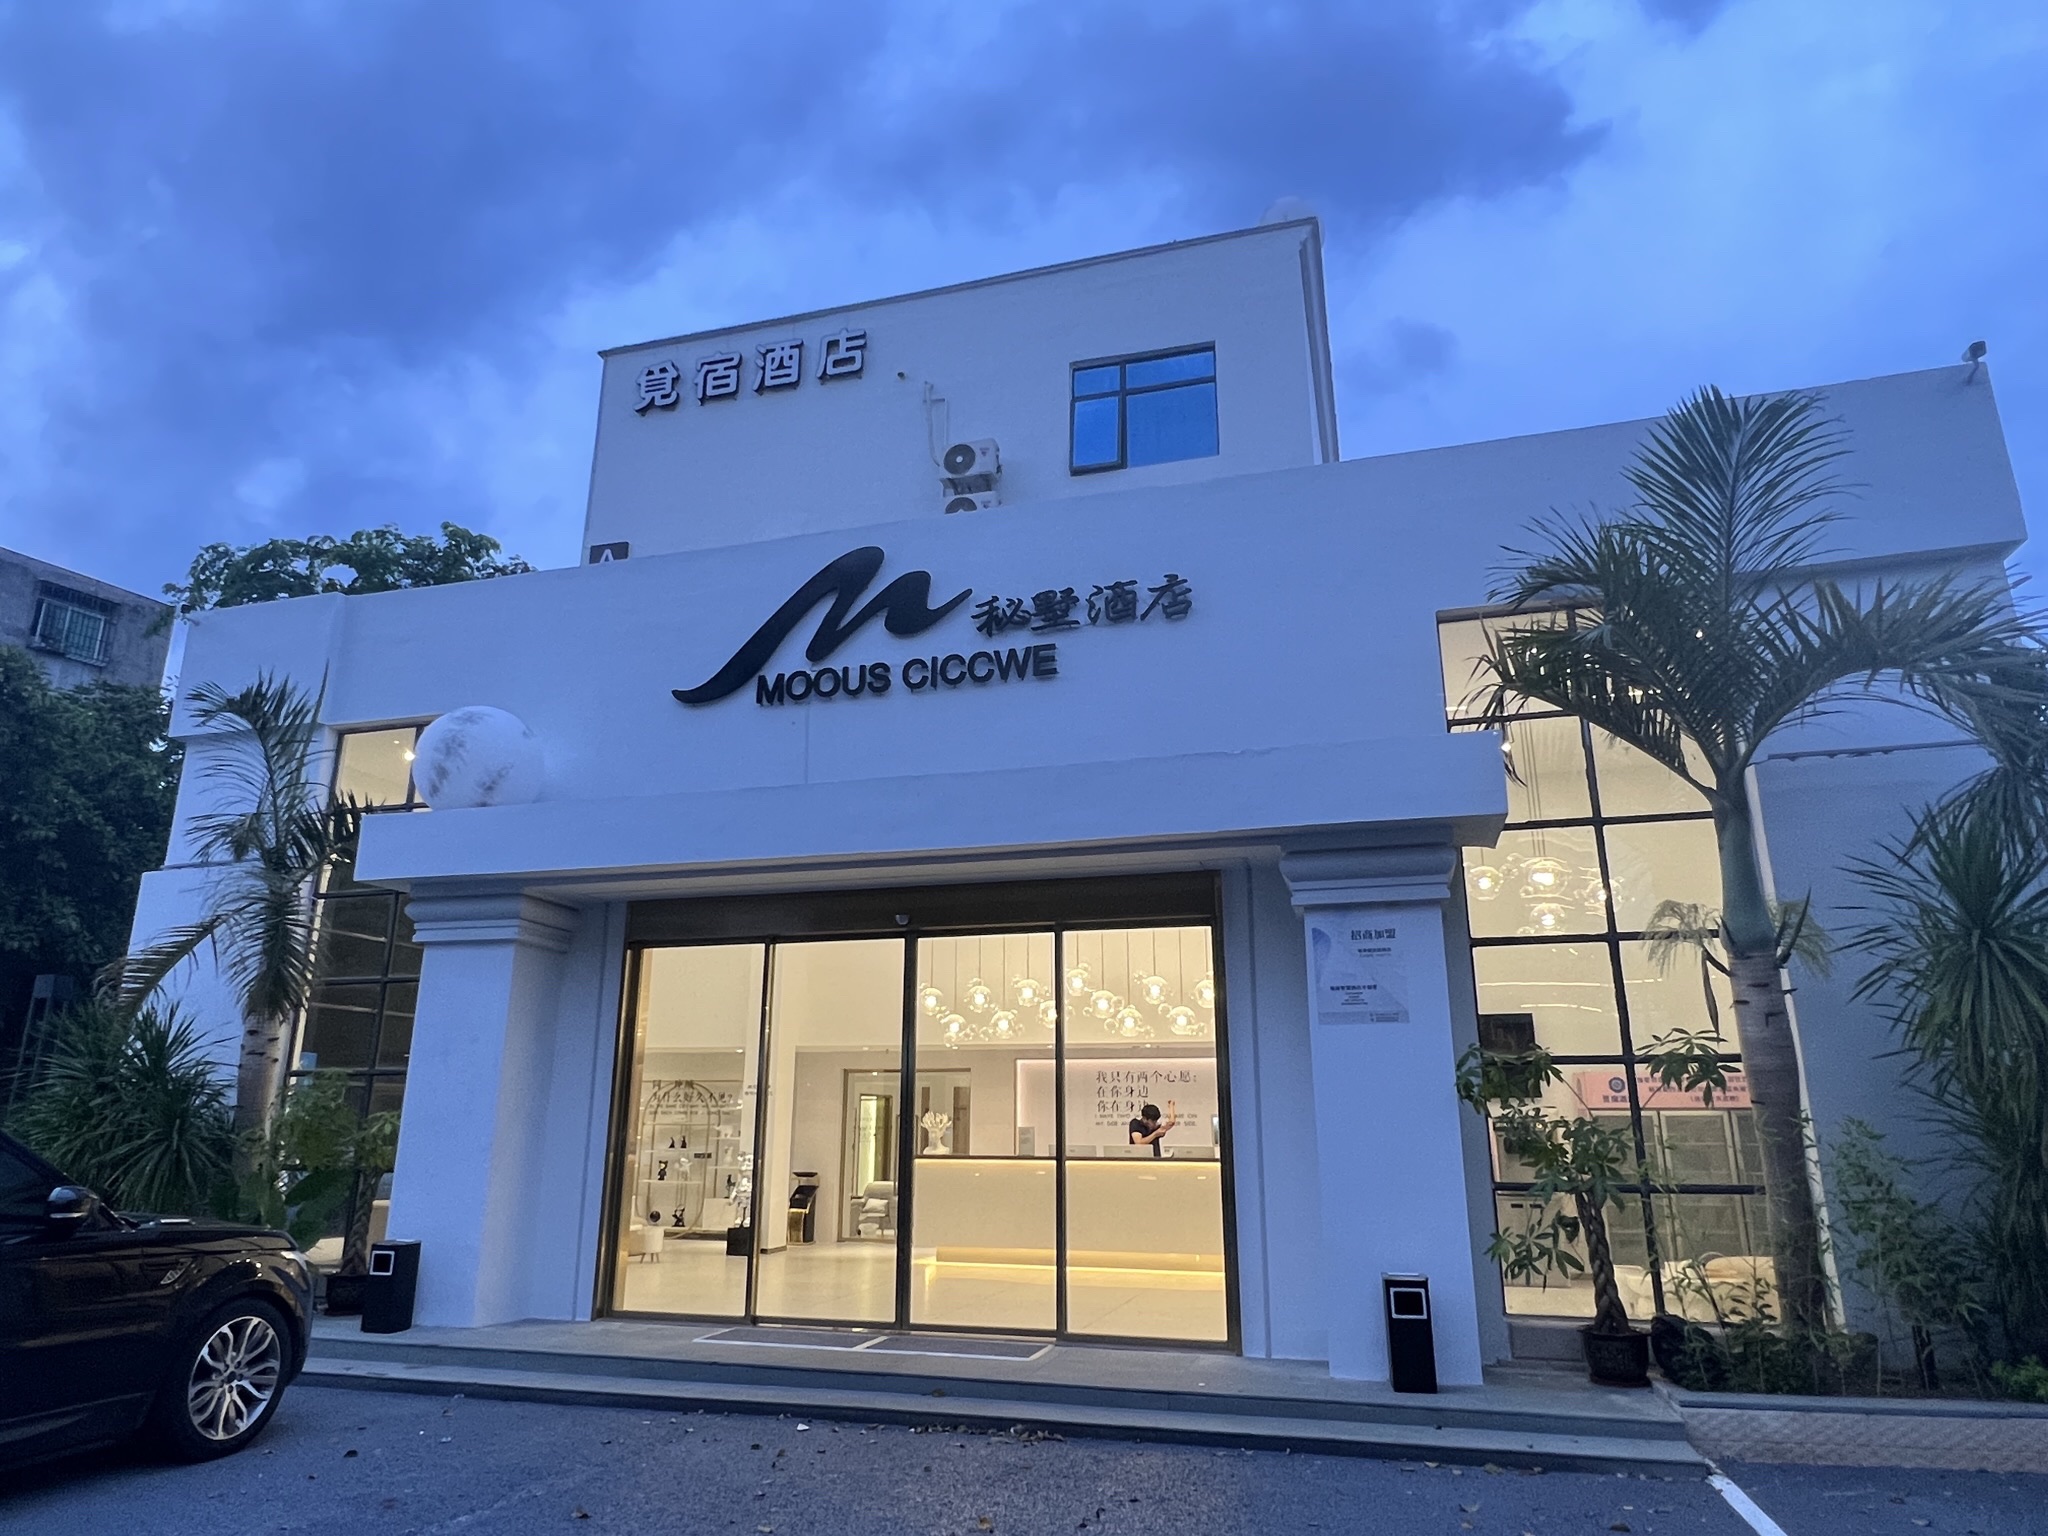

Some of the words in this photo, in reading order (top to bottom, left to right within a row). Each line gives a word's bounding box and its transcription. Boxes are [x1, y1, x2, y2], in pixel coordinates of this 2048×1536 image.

[970, 573, 1193, 638] 秘墅酒店
[756, 662, 892, 706] MOOUS
[902, 643, 1058, 693] CICCWE
